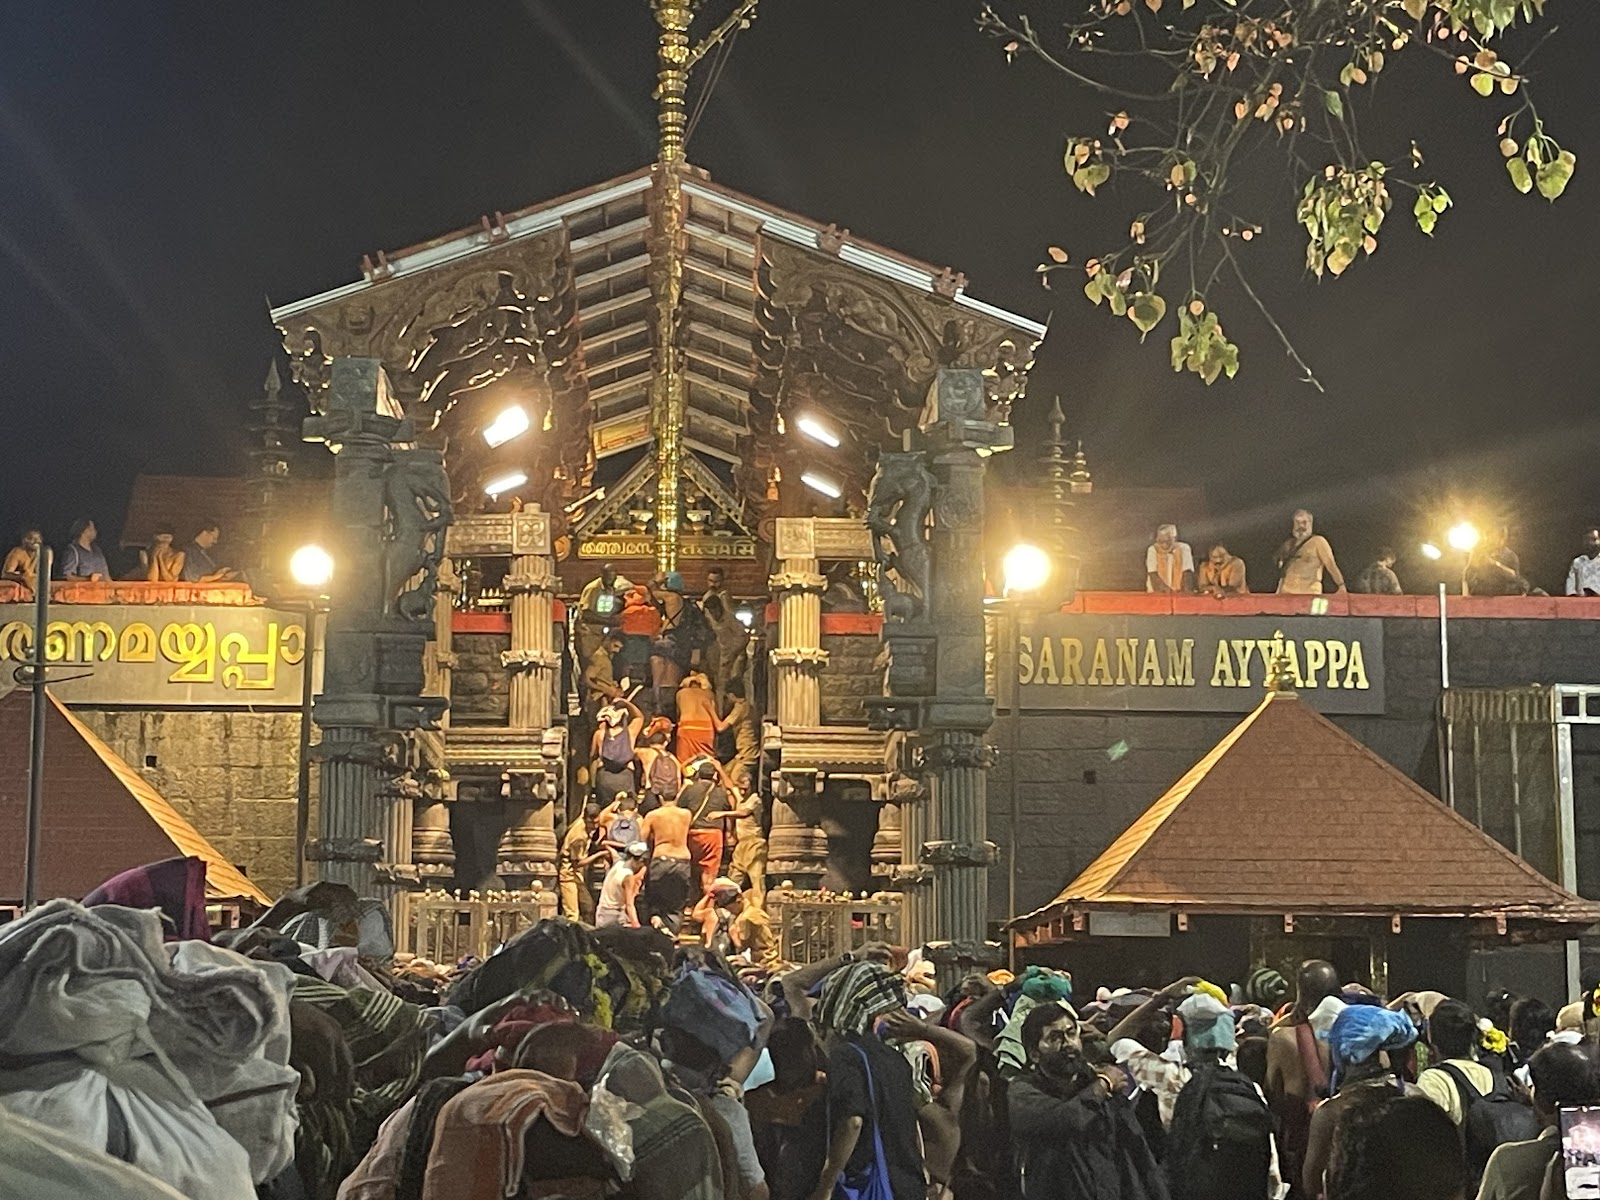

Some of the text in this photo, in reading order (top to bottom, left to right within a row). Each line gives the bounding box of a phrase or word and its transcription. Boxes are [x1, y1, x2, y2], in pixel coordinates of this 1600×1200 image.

[580, 541, 654, 555] തത്ത്വമസ
[1018, 635, 1370, 690] SARANAM AYYAPPA
